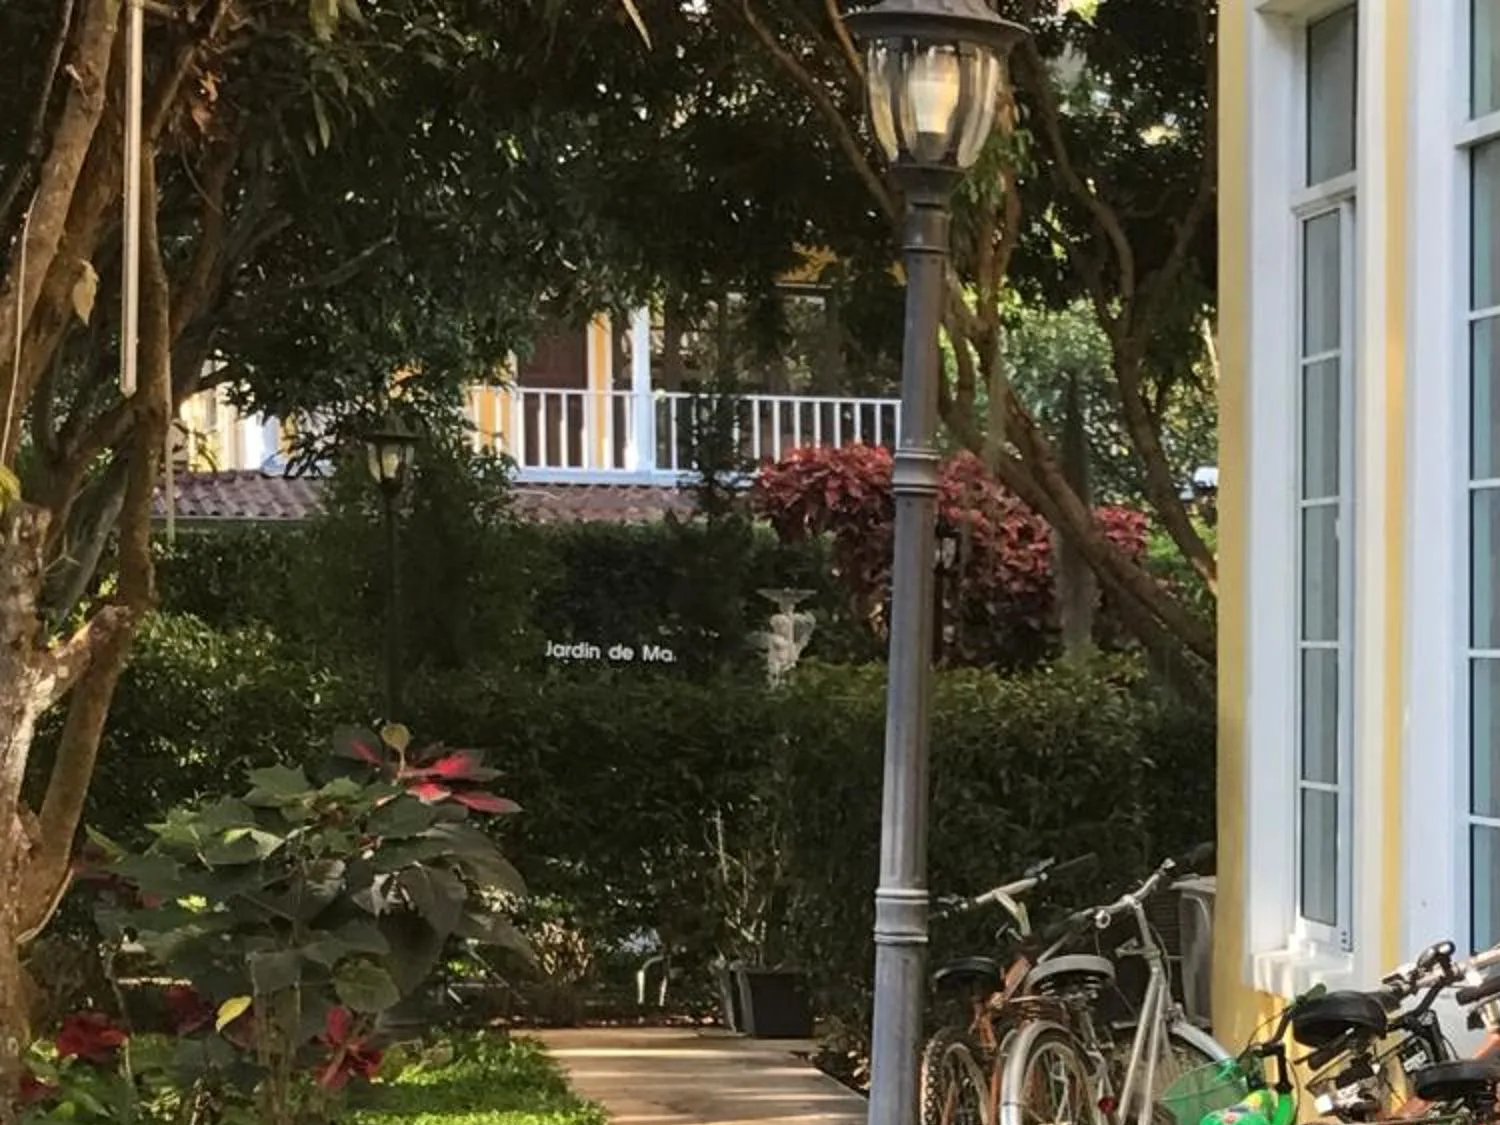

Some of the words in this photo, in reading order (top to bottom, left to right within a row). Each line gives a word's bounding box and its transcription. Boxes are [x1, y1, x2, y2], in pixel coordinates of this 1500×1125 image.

[545, 639, 600, 660] Jardin
[608, 643, 634, 661] de
[642, 644, 677, 663] Ma
